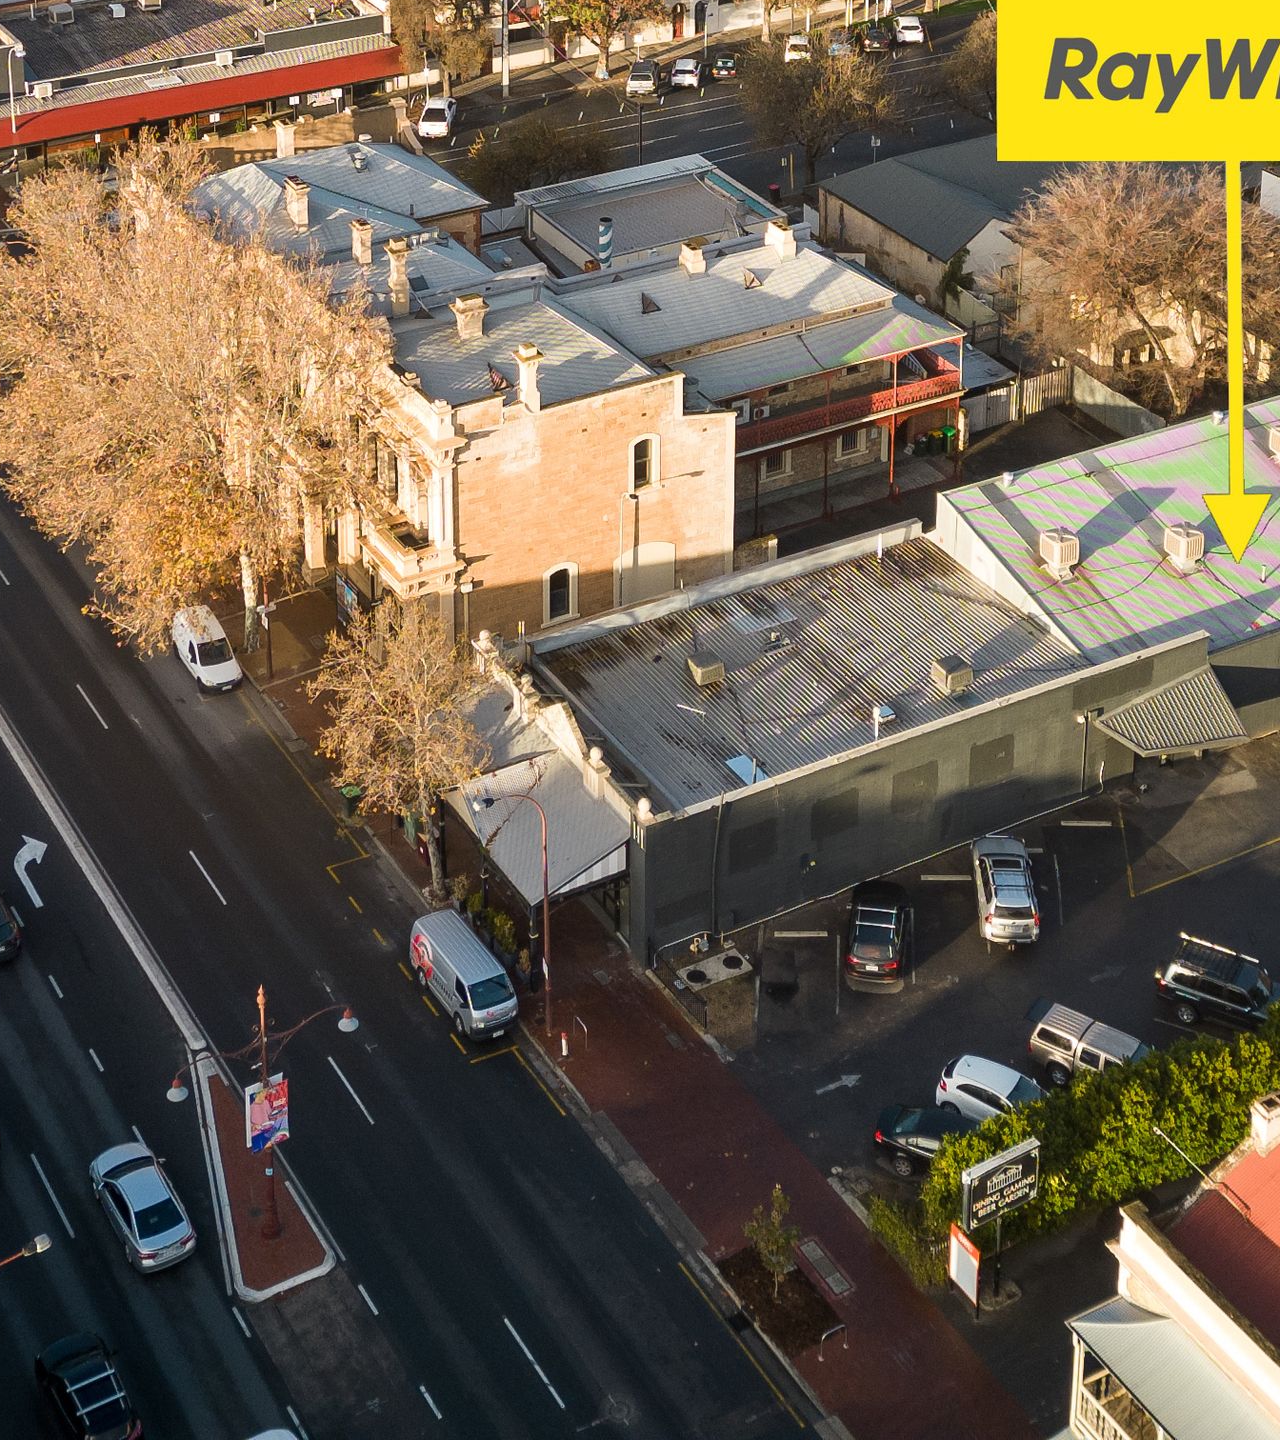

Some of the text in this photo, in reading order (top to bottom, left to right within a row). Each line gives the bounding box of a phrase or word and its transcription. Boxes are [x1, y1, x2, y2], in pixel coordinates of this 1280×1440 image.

[973, 1175, 1035, 1212] DINING GAMING
[978, 1187, 1030, 1218] BEER GARDEN
